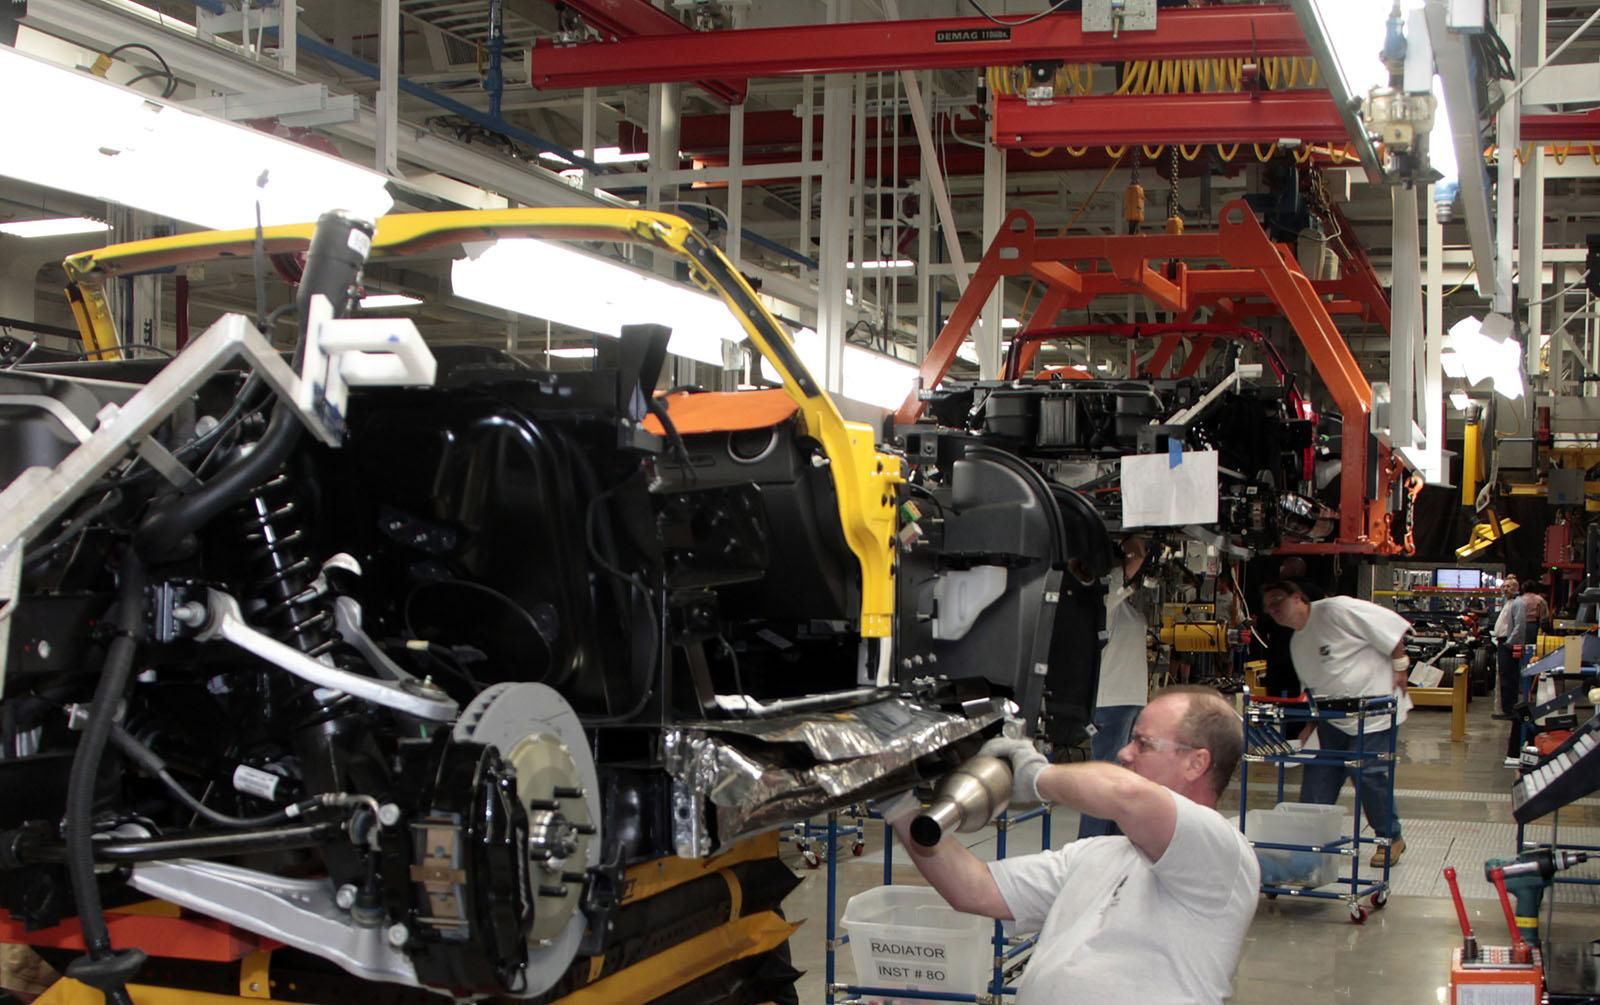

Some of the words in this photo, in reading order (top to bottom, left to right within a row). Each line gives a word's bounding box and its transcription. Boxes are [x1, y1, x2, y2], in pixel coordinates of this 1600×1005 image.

[937, 31, 978, 41] DEMAG
[871, 942, 945, 959] RADIATOR
[878, 965, 910, 978] INST
[914, 970, 923, 979] #
